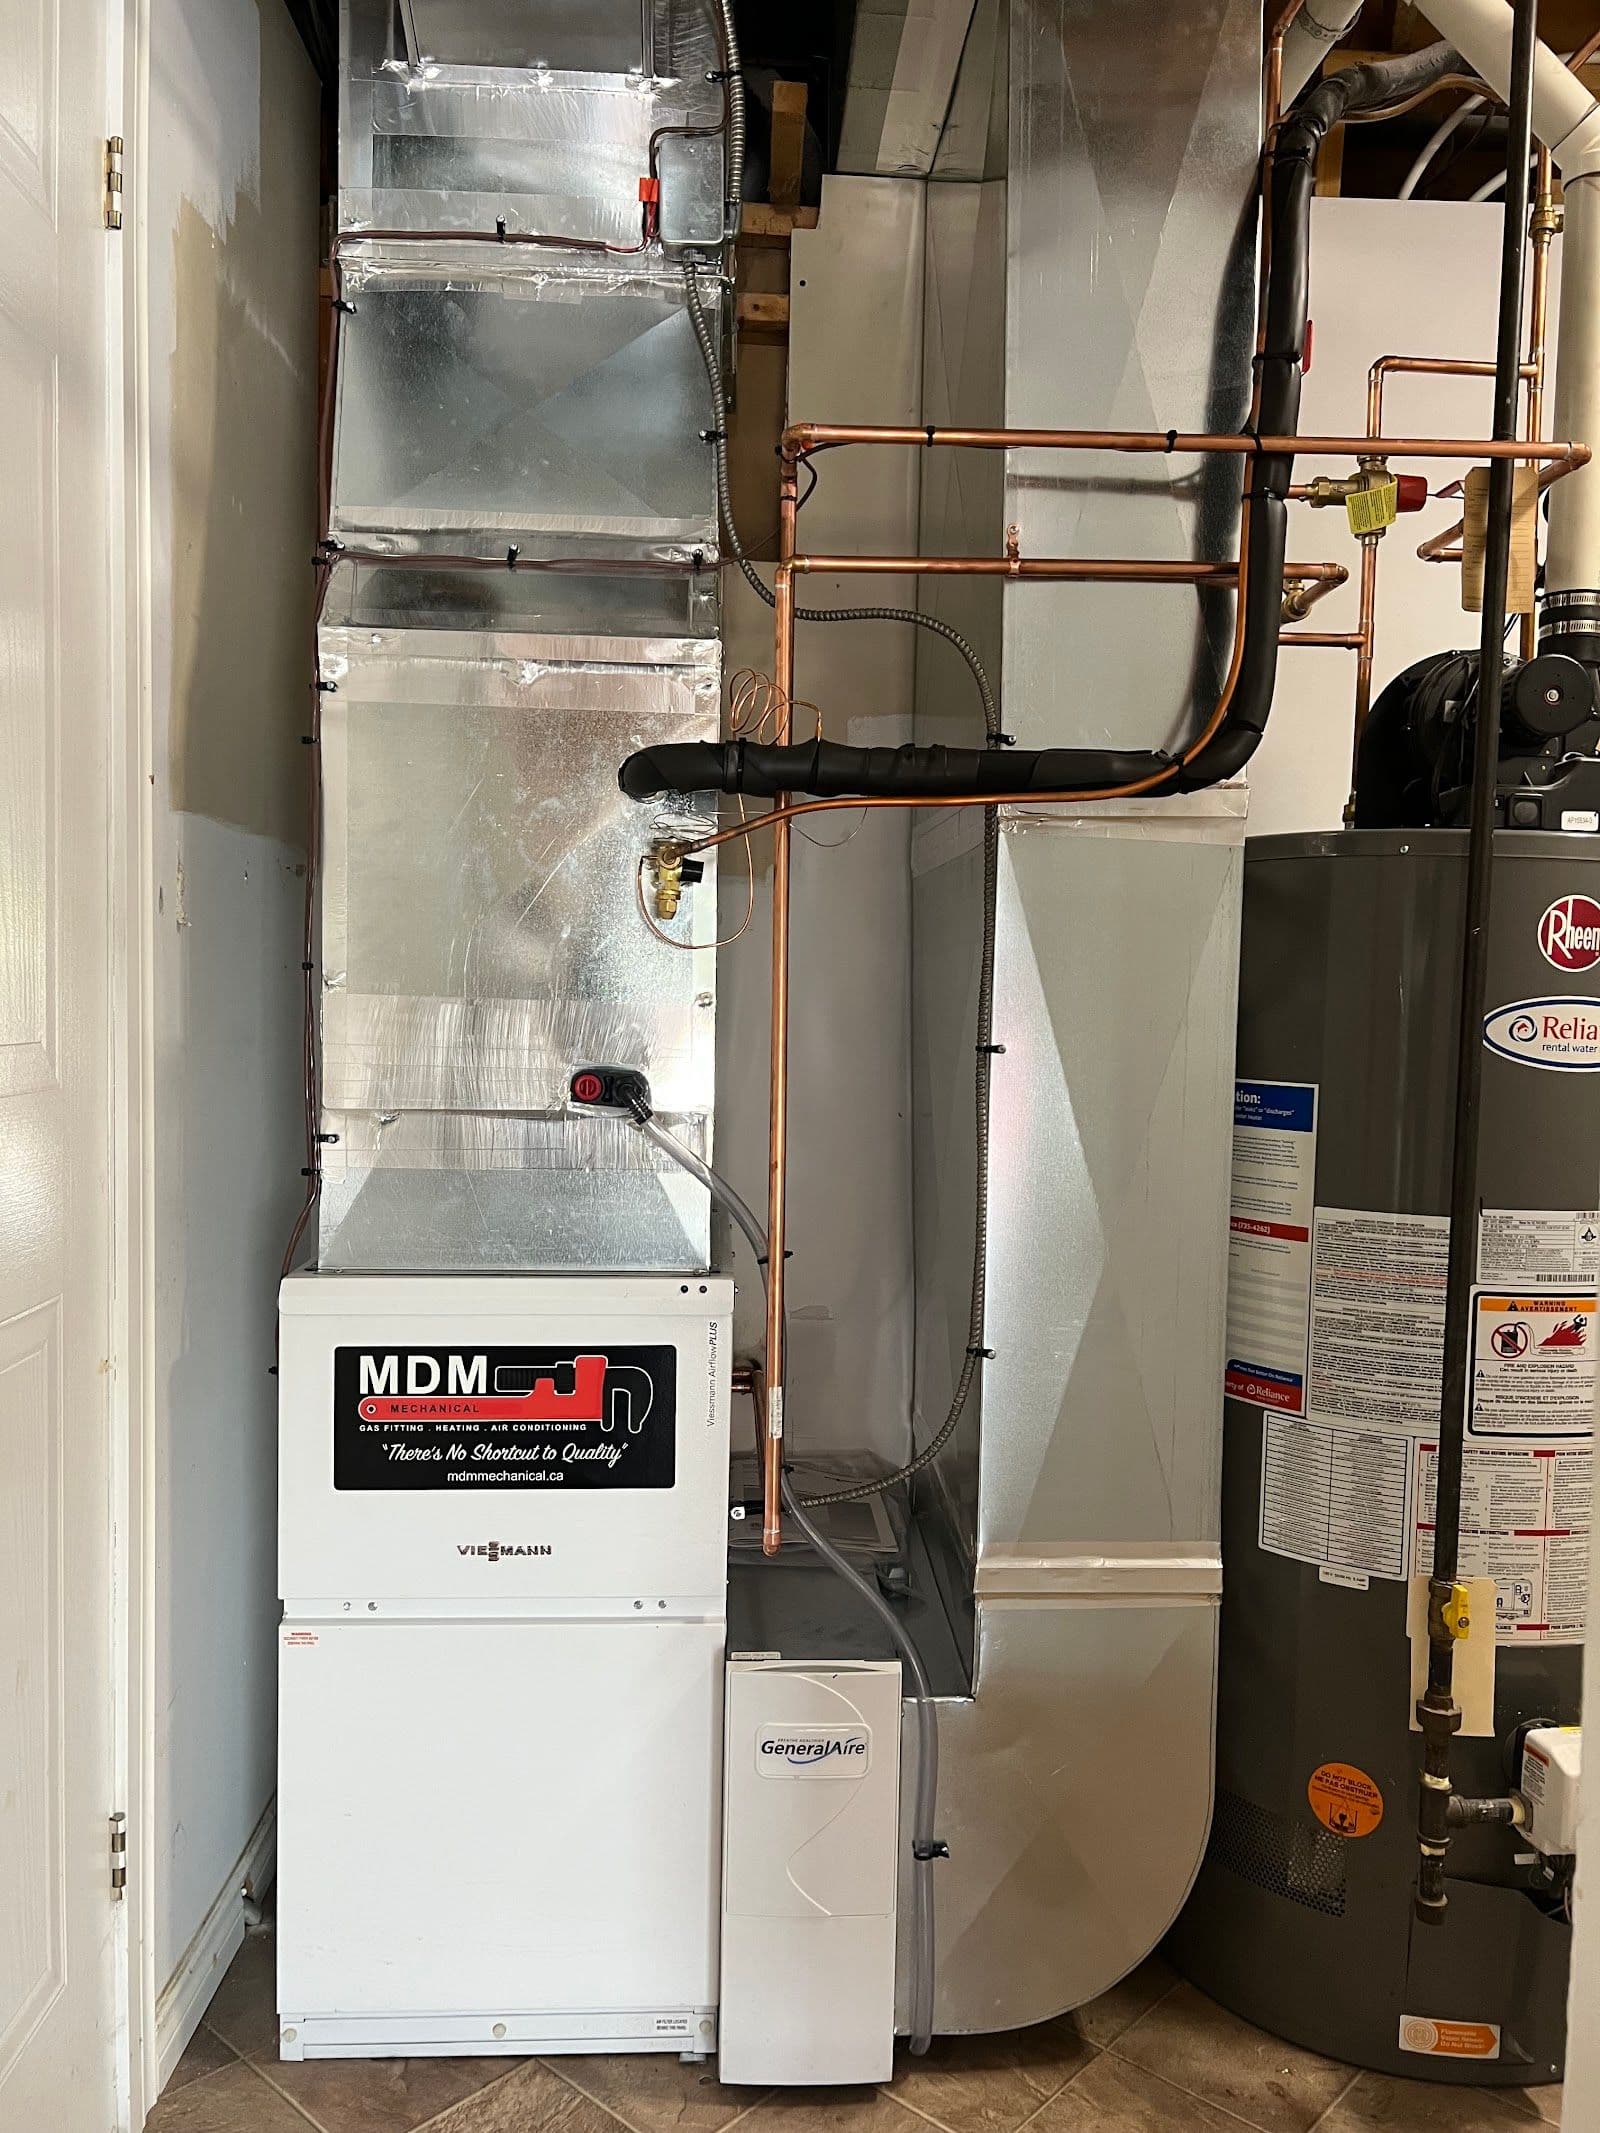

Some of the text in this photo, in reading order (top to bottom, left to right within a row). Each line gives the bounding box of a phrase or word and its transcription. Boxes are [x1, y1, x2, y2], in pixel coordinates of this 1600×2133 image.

[1542, 1016, 1600, 1040] Relia
[1542, 1042, 1570, 1052] rental
[1236, 1090, 1260, 1104] tion:
[360, 1355, 488, 1394] MDM
[1256, 1386, 1290, 1402] Reliance
[390, 1404, 480, 1413] MECHANICAL
[706, 1380, 716, 1427] Viessmann
[512, 1424, 587, 1432] CONDITIONING
[382, 1442, 629, 1468] "There's No Shortcut to Quality"
[447, 1470, 564, 1482] mdmmechanical.ca
[761, 1740, 865, 1755] GeneralAire
[1325, 1779, 1338, 1788] PAS
[1332, 1774, 1346, 1783] NOT
